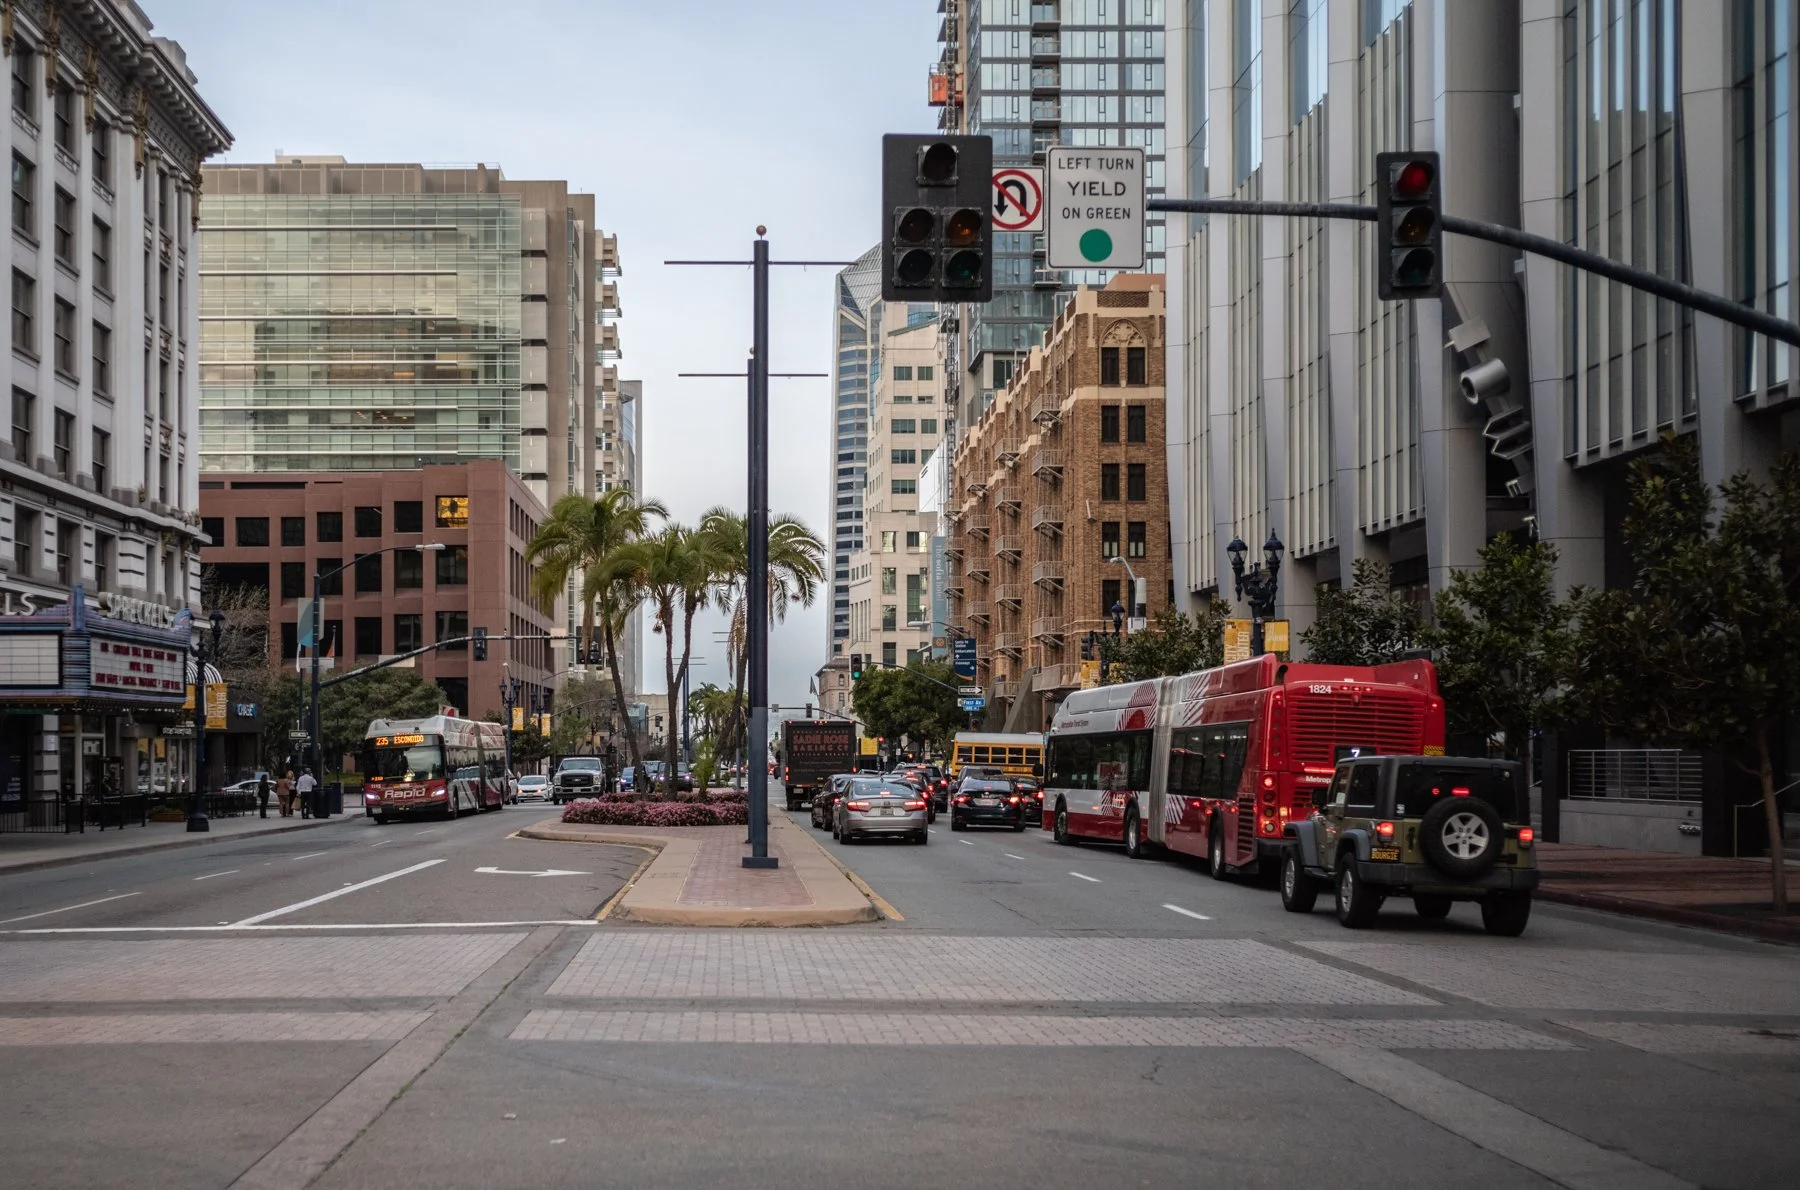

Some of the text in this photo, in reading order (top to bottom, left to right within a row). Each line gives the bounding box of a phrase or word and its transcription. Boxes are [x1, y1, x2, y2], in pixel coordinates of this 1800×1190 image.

[1058, 157, 1134, 170] LEFT TURN
[1067, 181, 1126, 196] YIELD
[1062, 207, 1131, 219] ON GREEN
[935, 545, 944, 558] the
[935, 581, 944, 601] hotel
[1308, 684, 1332, 693] 1824
[207, 703, 217, 718] CITY
[216, 692, 226, 718] CENTER
[376, 735, 424, 746] 235 ESCONDIDO
[793, 734, 849, 744] SADIE ROSE
[1351, 749, 1360, 758] 7
[1305, 775, 1332, 784] Metrop
[384, 788, 426, 799] Rapid
